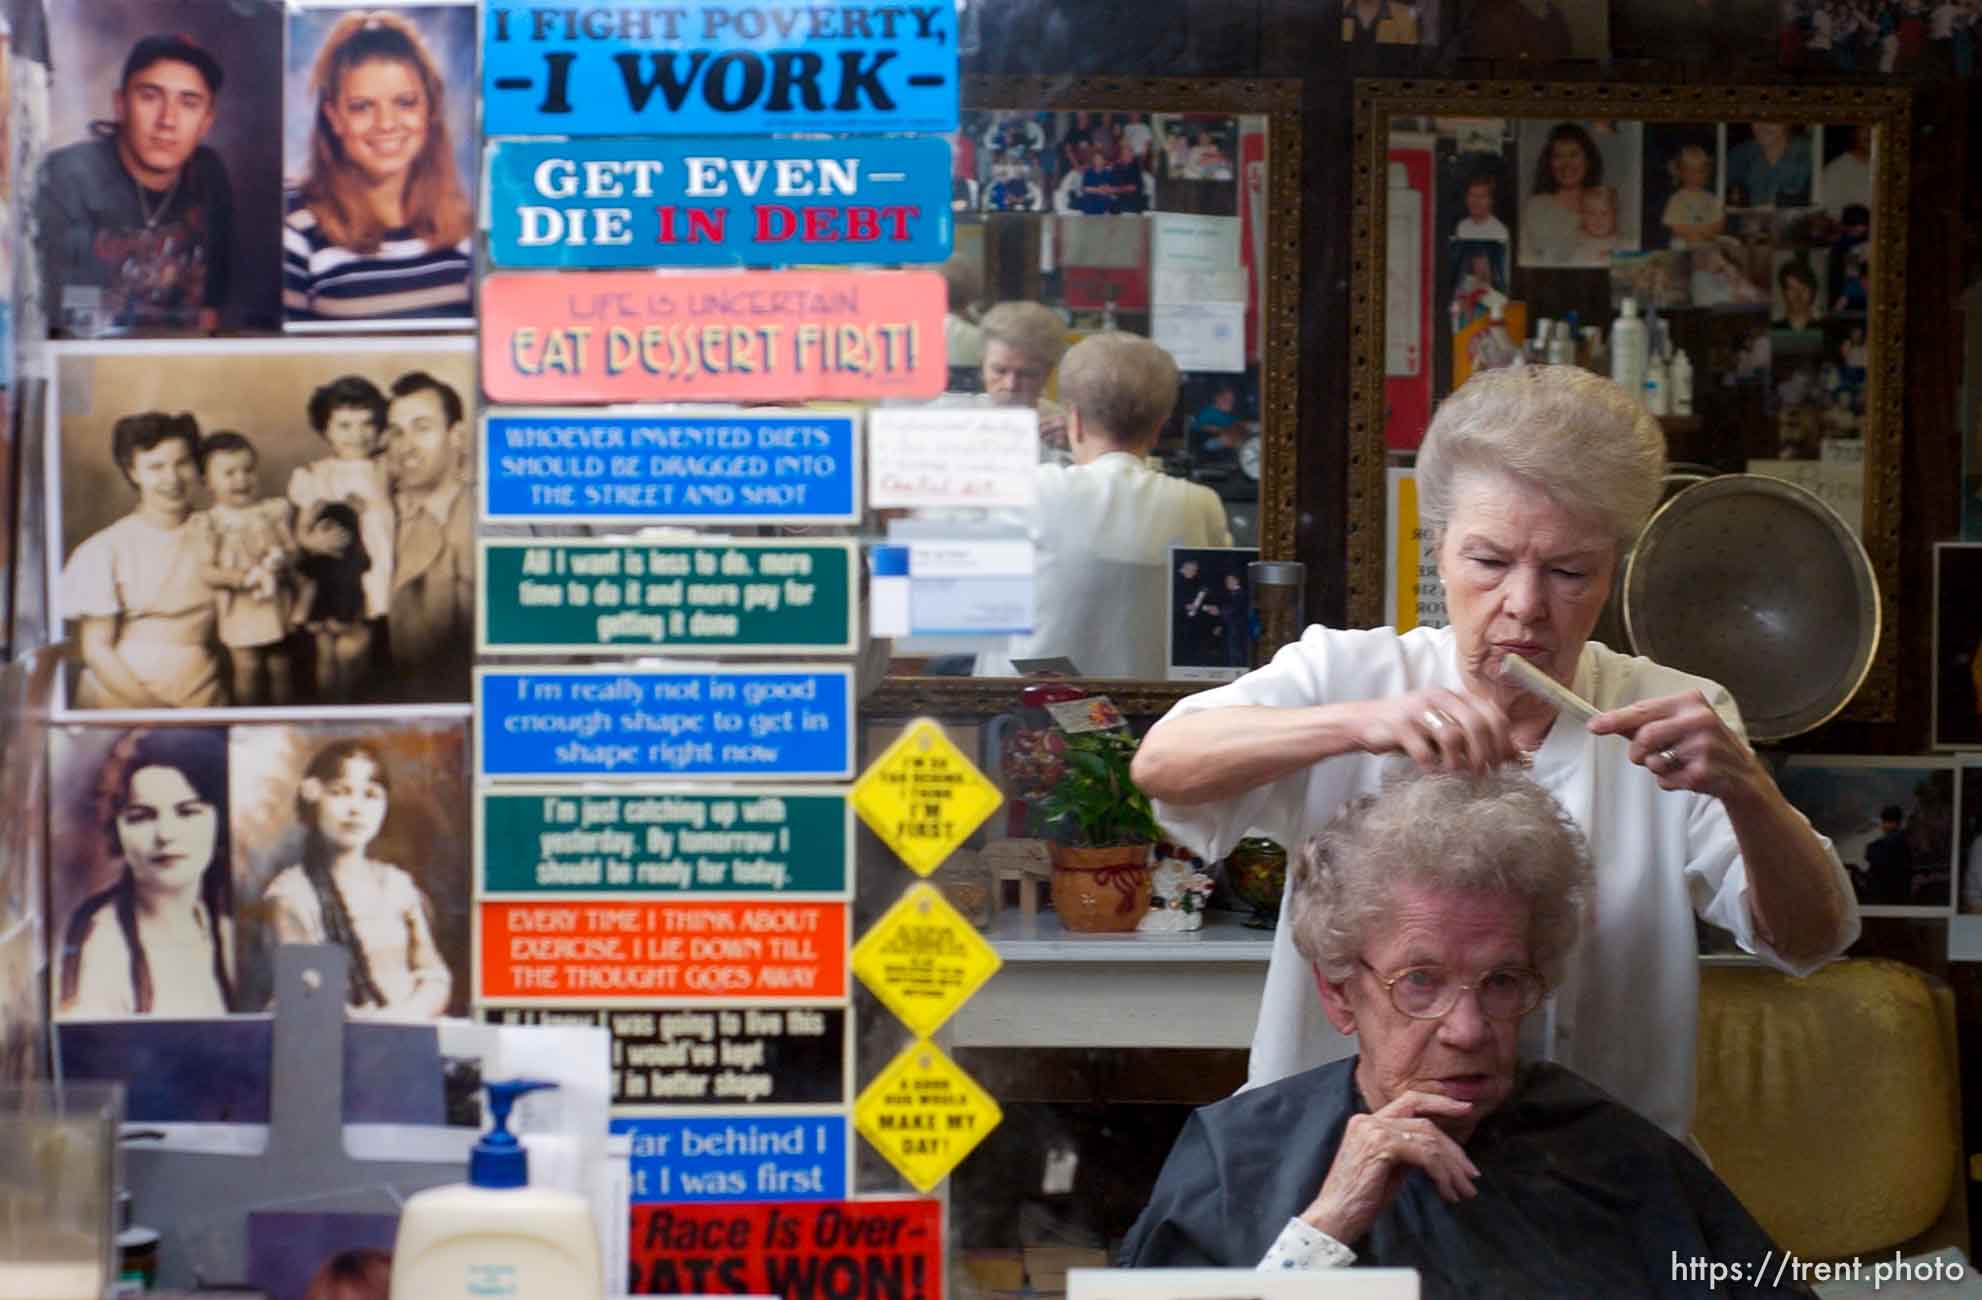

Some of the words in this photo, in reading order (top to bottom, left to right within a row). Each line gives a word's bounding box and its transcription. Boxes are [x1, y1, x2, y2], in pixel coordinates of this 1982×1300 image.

[494, 9, 510, 41] I
[531, 8, 688, 40] FIGHT
[702, 7, 946, 45] POVERTY,
[534, 158, 664, 199] GET
[517, 207, 633, 246] DIE
[656, 205, 730, 244] IN
[753, 205, 920, 244] DEBT
[569, 293, 638, 319] LIFE
[649, 294, 675, 318] IS
[687, 286, 860, 318] UNCERTAIN
[512, 324, 593, 377] EAT
[606, 322, 783, 382] DESSERT
[794, 322, 920, 379] FIRST!
[505, 426, 625, 448] WHOEVER
[631, 426, 752, 448] INVENTED
[758, 426, 831, 448] DIETS
[501, 456, 604, 477] SHOULD
[611, 456, 642, 477] BE
[651, 456, 768, 477] DRAGGED
[775, 456, 836, 477] INTO
[531, 484, 575, 506] THE
[585, 484, 675, 506] STREET
[683, 484, 734, 506] AND
[740, 484, 808, 506] SHOT
[522, 549, 551, 575] All
[556, 549, 565, 575] I
[569, 553, 620, 575] want
[624, 549, 645, 575] is
[649, 549, 691, 575] less
[694, 549, 717, 575] to
[759, 553, 812, 575] more
[519, 579, 562, 606] time
[567, 579, 589, 606] to
[593, 579, 621, 606] do
[624, 579, 641, 606] it
[645, 579, 683, 606] and
[687, 584, 739, 606] more
[743, 583, 781, 611] pay
[785, 579, 816, 605] for
[596, 611, 665, 642] getting
[669, 610, 686, 636] it
[689, 610, 738, 636] done
[518, 678, 562, 701] I'm
[571, 678, 644, 705] really
[654, 679, 701, 700] not
[710, 678, 736, 700] in
[743, 678, 817, 705] good
[504, 711, 611, 737] enough
[620, 710, 703, 736] shape
[713, 712, 743, 731] to
[749, 712, 793, 737] get
[802, 709, 829, 731] in
[555, 740, 639, 769] shape
[648, 739, 713, 768] right
[722, 743, 778, 762] now
[544, 798, 577, 822] I'm
[581, 798, 619, 828] just
[624, 798, 706, 829] catching
[710, 801, 737, 829] up
[741, 798, 786, 822] with
[646, 827, 674, 859] By
[678, 829, 774, 853] tomorrow
[780, 827, 790, 853] I
[536, 858, 601, 884] should
[606, 858, 632, 884] be
[637, 858, 692, 890] ready
[697, 858, 727, 884] for
[508, 909, 578, 933] EVERY
[586, 909, 641, 933] TIME
[649, 909, 657, 933] I
[663, 909, 735, 933] THINK
[742, 909, 820, 933] ABOUT
[634, 938, 641, 961] I
[649, 938, 684, 961] LIE
[690, 938, 763, 961] DOWN
[769, 937, 818, 960] TILL
[511, 966, 558, 989] THE
[564, 966, 679, 989] THOUGHT
[685, 965, 752, 989] GOES
[757, 965, 818, 989] AWAY
[612, 1014, 654, 1036] was
[660, 1010, 715, 1042] going
[719, 1011, 741, 1035] to
[744, 1011, 782, 1035] live
[786, 1010, 825, 1035] this
[719, 1039, 764, 1071] kept
[625, 1070, 647, 1097] in
[651, 1070, 709, 1097] better
[714, 1071, 773, 1101] shape
[878, 1115, 935, 1129] MAKE
[947, 1115, 975, 1129] MY
[682, 1125, 803, 1157] behind
[817, 1125, 826, 1154] I
[660, 1167, 669, 1194] I
[680, 1170, 747, 1194] was
[757, 1163, 823, 1193] first
[645, 1210, 751, 1251] Race
